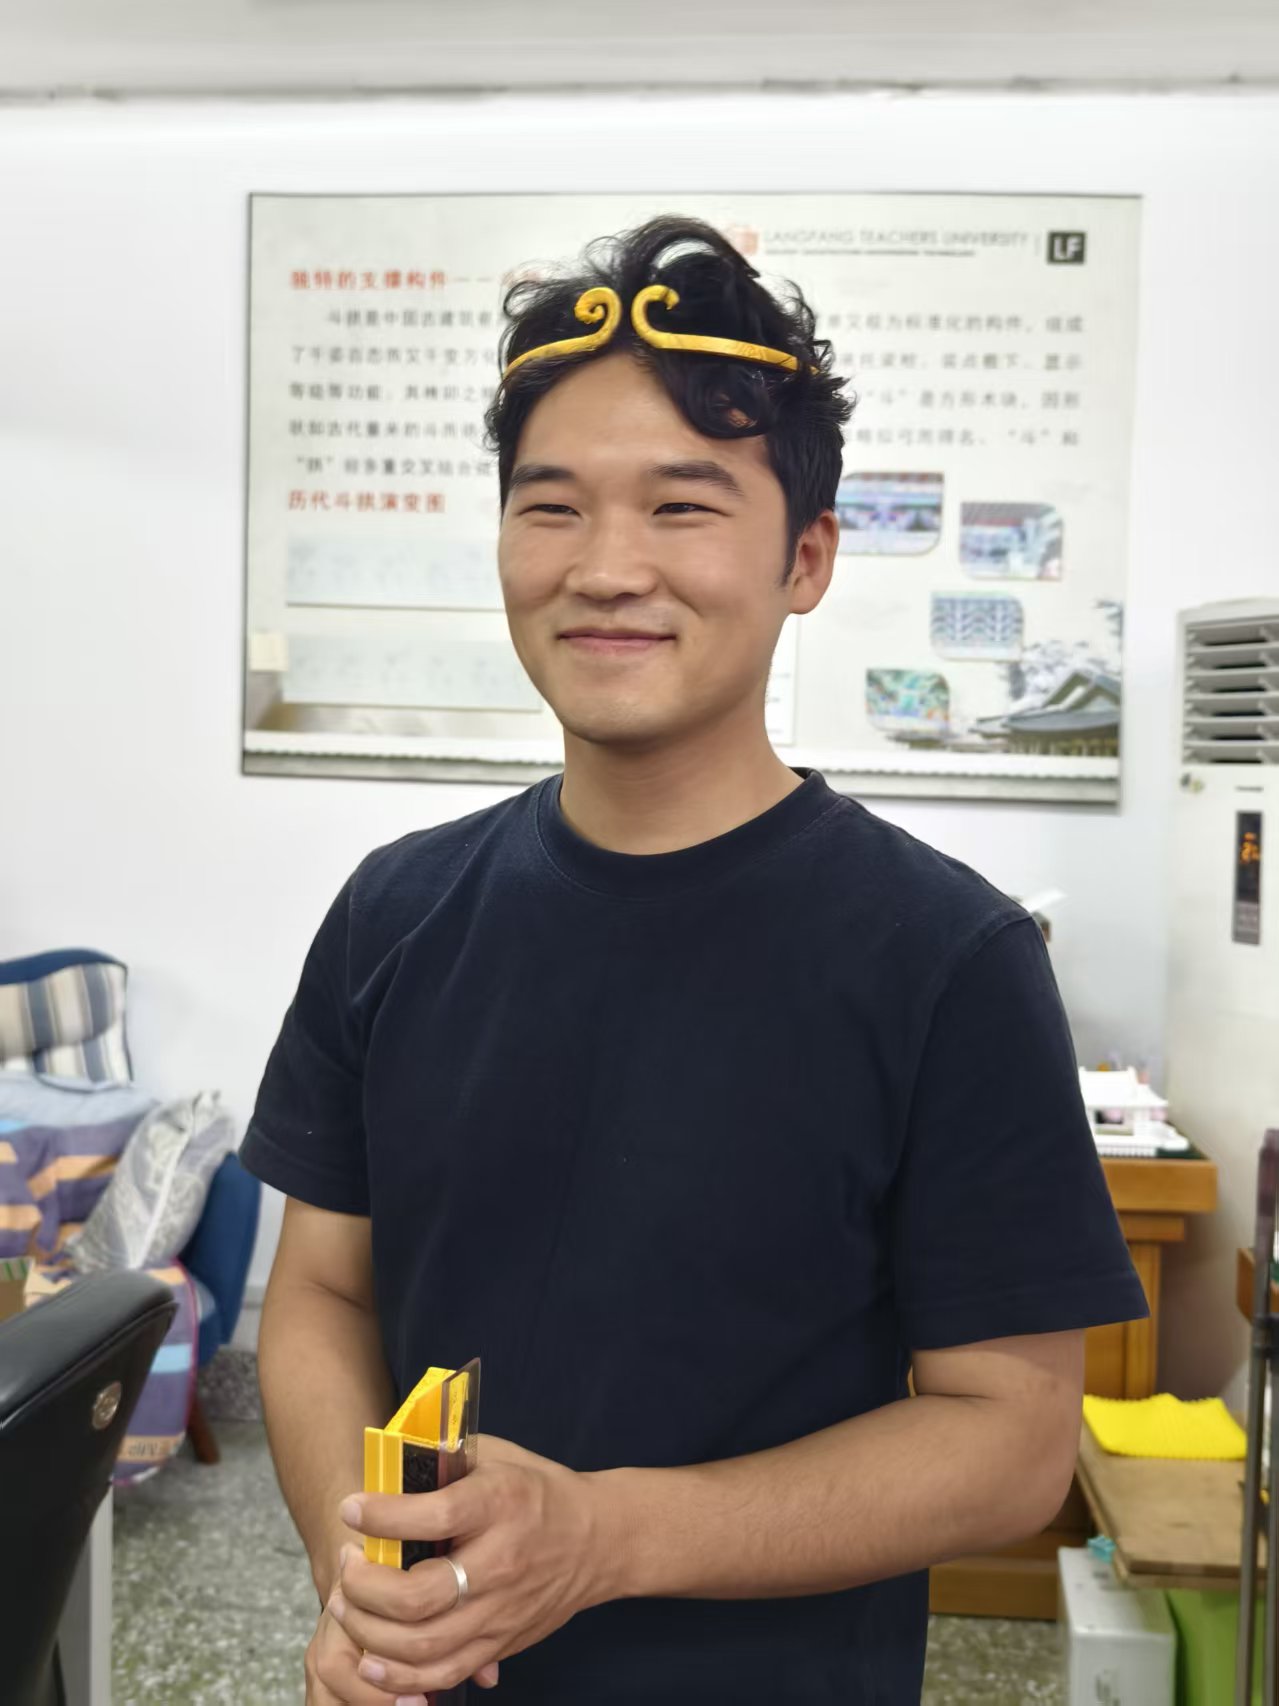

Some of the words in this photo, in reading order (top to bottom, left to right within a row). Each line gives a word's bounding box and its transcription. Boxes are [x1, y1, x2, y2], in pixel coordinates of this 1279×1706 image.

[765, 229, 854, 245] LANGFANG
[859, 230, 938, 246] TEACHERS
[943, 230, 1029, 247] UNIVERSITY
[1053, 236, 1082, 261] LF
